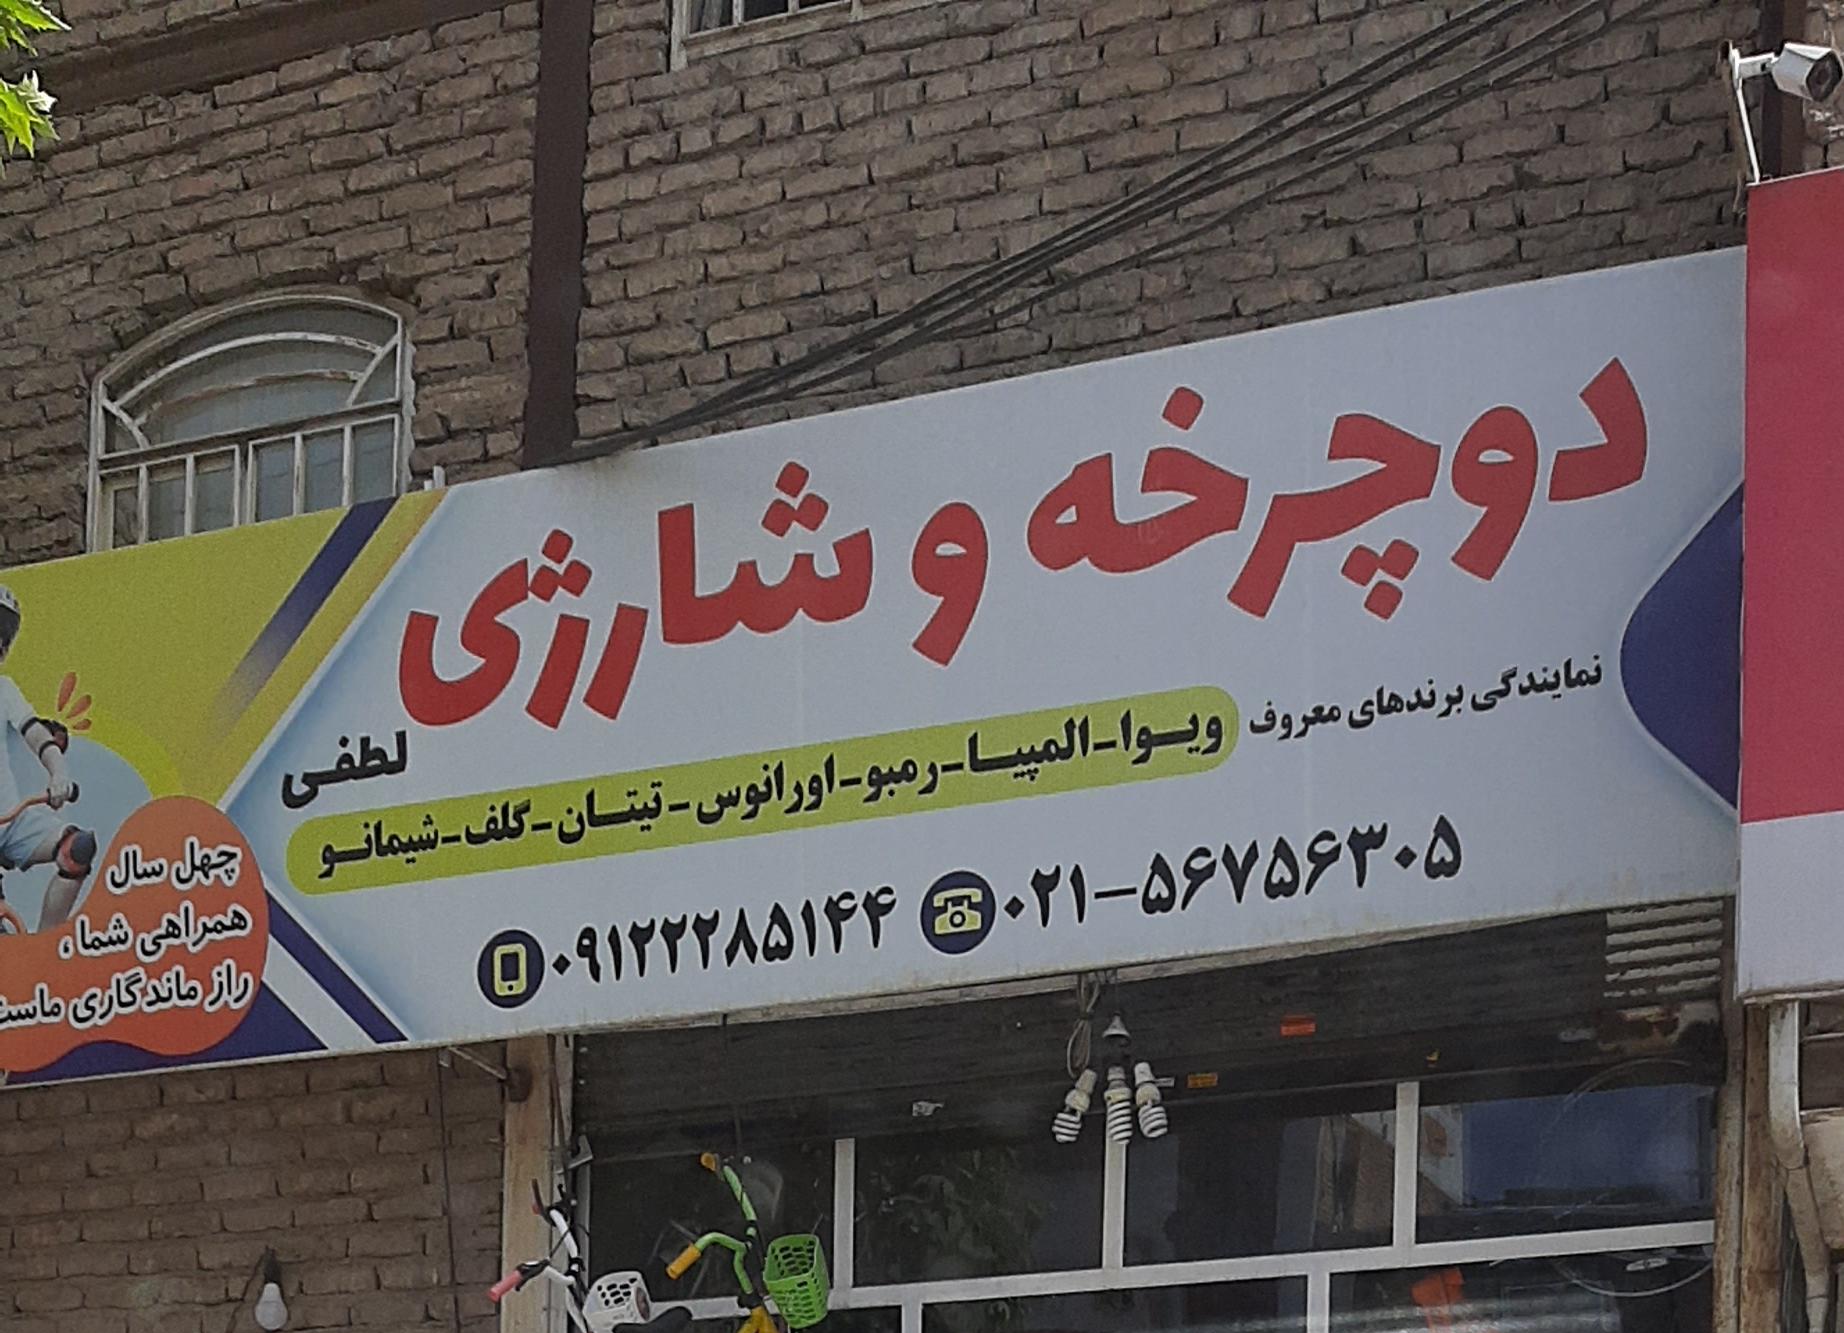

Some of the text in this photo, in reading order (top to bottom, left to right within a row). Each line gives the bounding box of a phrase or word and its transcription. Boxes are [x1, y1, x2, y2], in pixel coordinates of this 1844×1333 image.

[399, 356, 1647, 729] دوچرخه و شارژی
[1249, 653, 1602, 743] نمایندگی برندهای معروف
[281, 730, 408, 809] لطفی
[110, 840, 238, 889] چهل سال
[140, 905, 249, 956] همراهی
[551, 885, 897, 983] ۰۹۱۲۲۲۸۵۱۴۴
[72, 970, 199, 1024] ماندگاری
[207, 962, 250, 1007] راز
